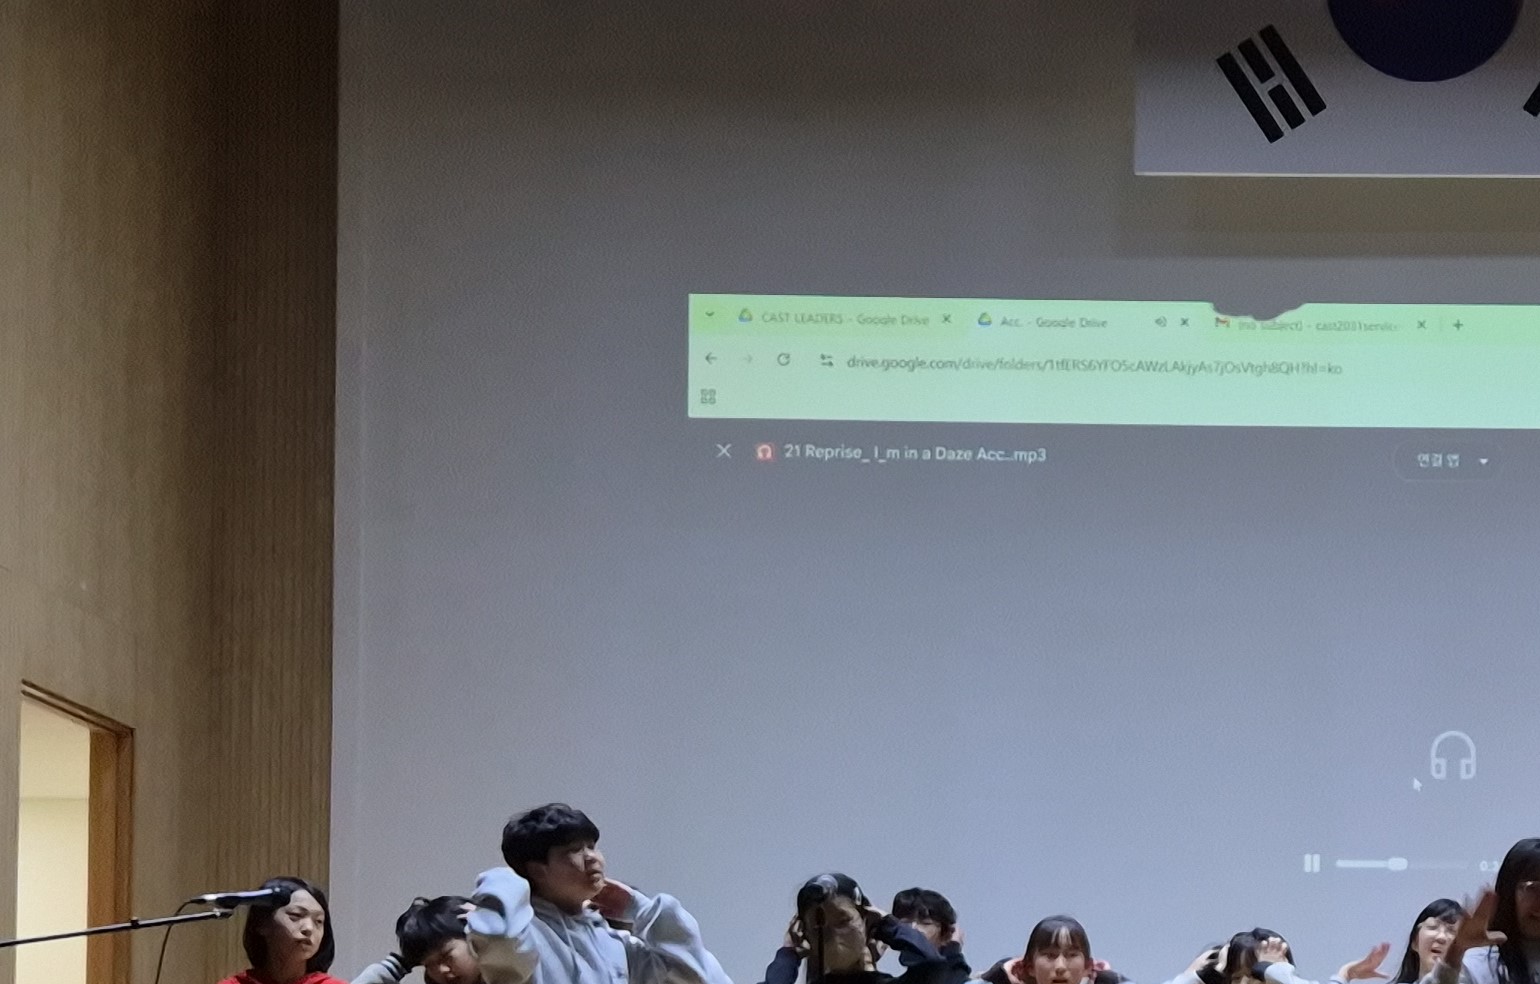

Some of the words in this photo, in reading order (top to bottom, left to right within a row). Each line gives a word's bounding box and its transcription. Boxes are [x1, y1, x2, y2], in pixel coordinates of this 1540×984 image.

[761, 311, 790, 323] CAST
[795, 312, 843, 325] LEADERS
[856, 313, 897, 327] Google
[901, 314, 929, 326] Drive
[1035, 317, 1076, 329] Google
[1079, 317, 1108, 328] Drive
[784, 443, 801, 458] 21
[904, 445, 919, 459] in
[922, 449, 931, 460] a
[935, 446, 973, 460] Daze
